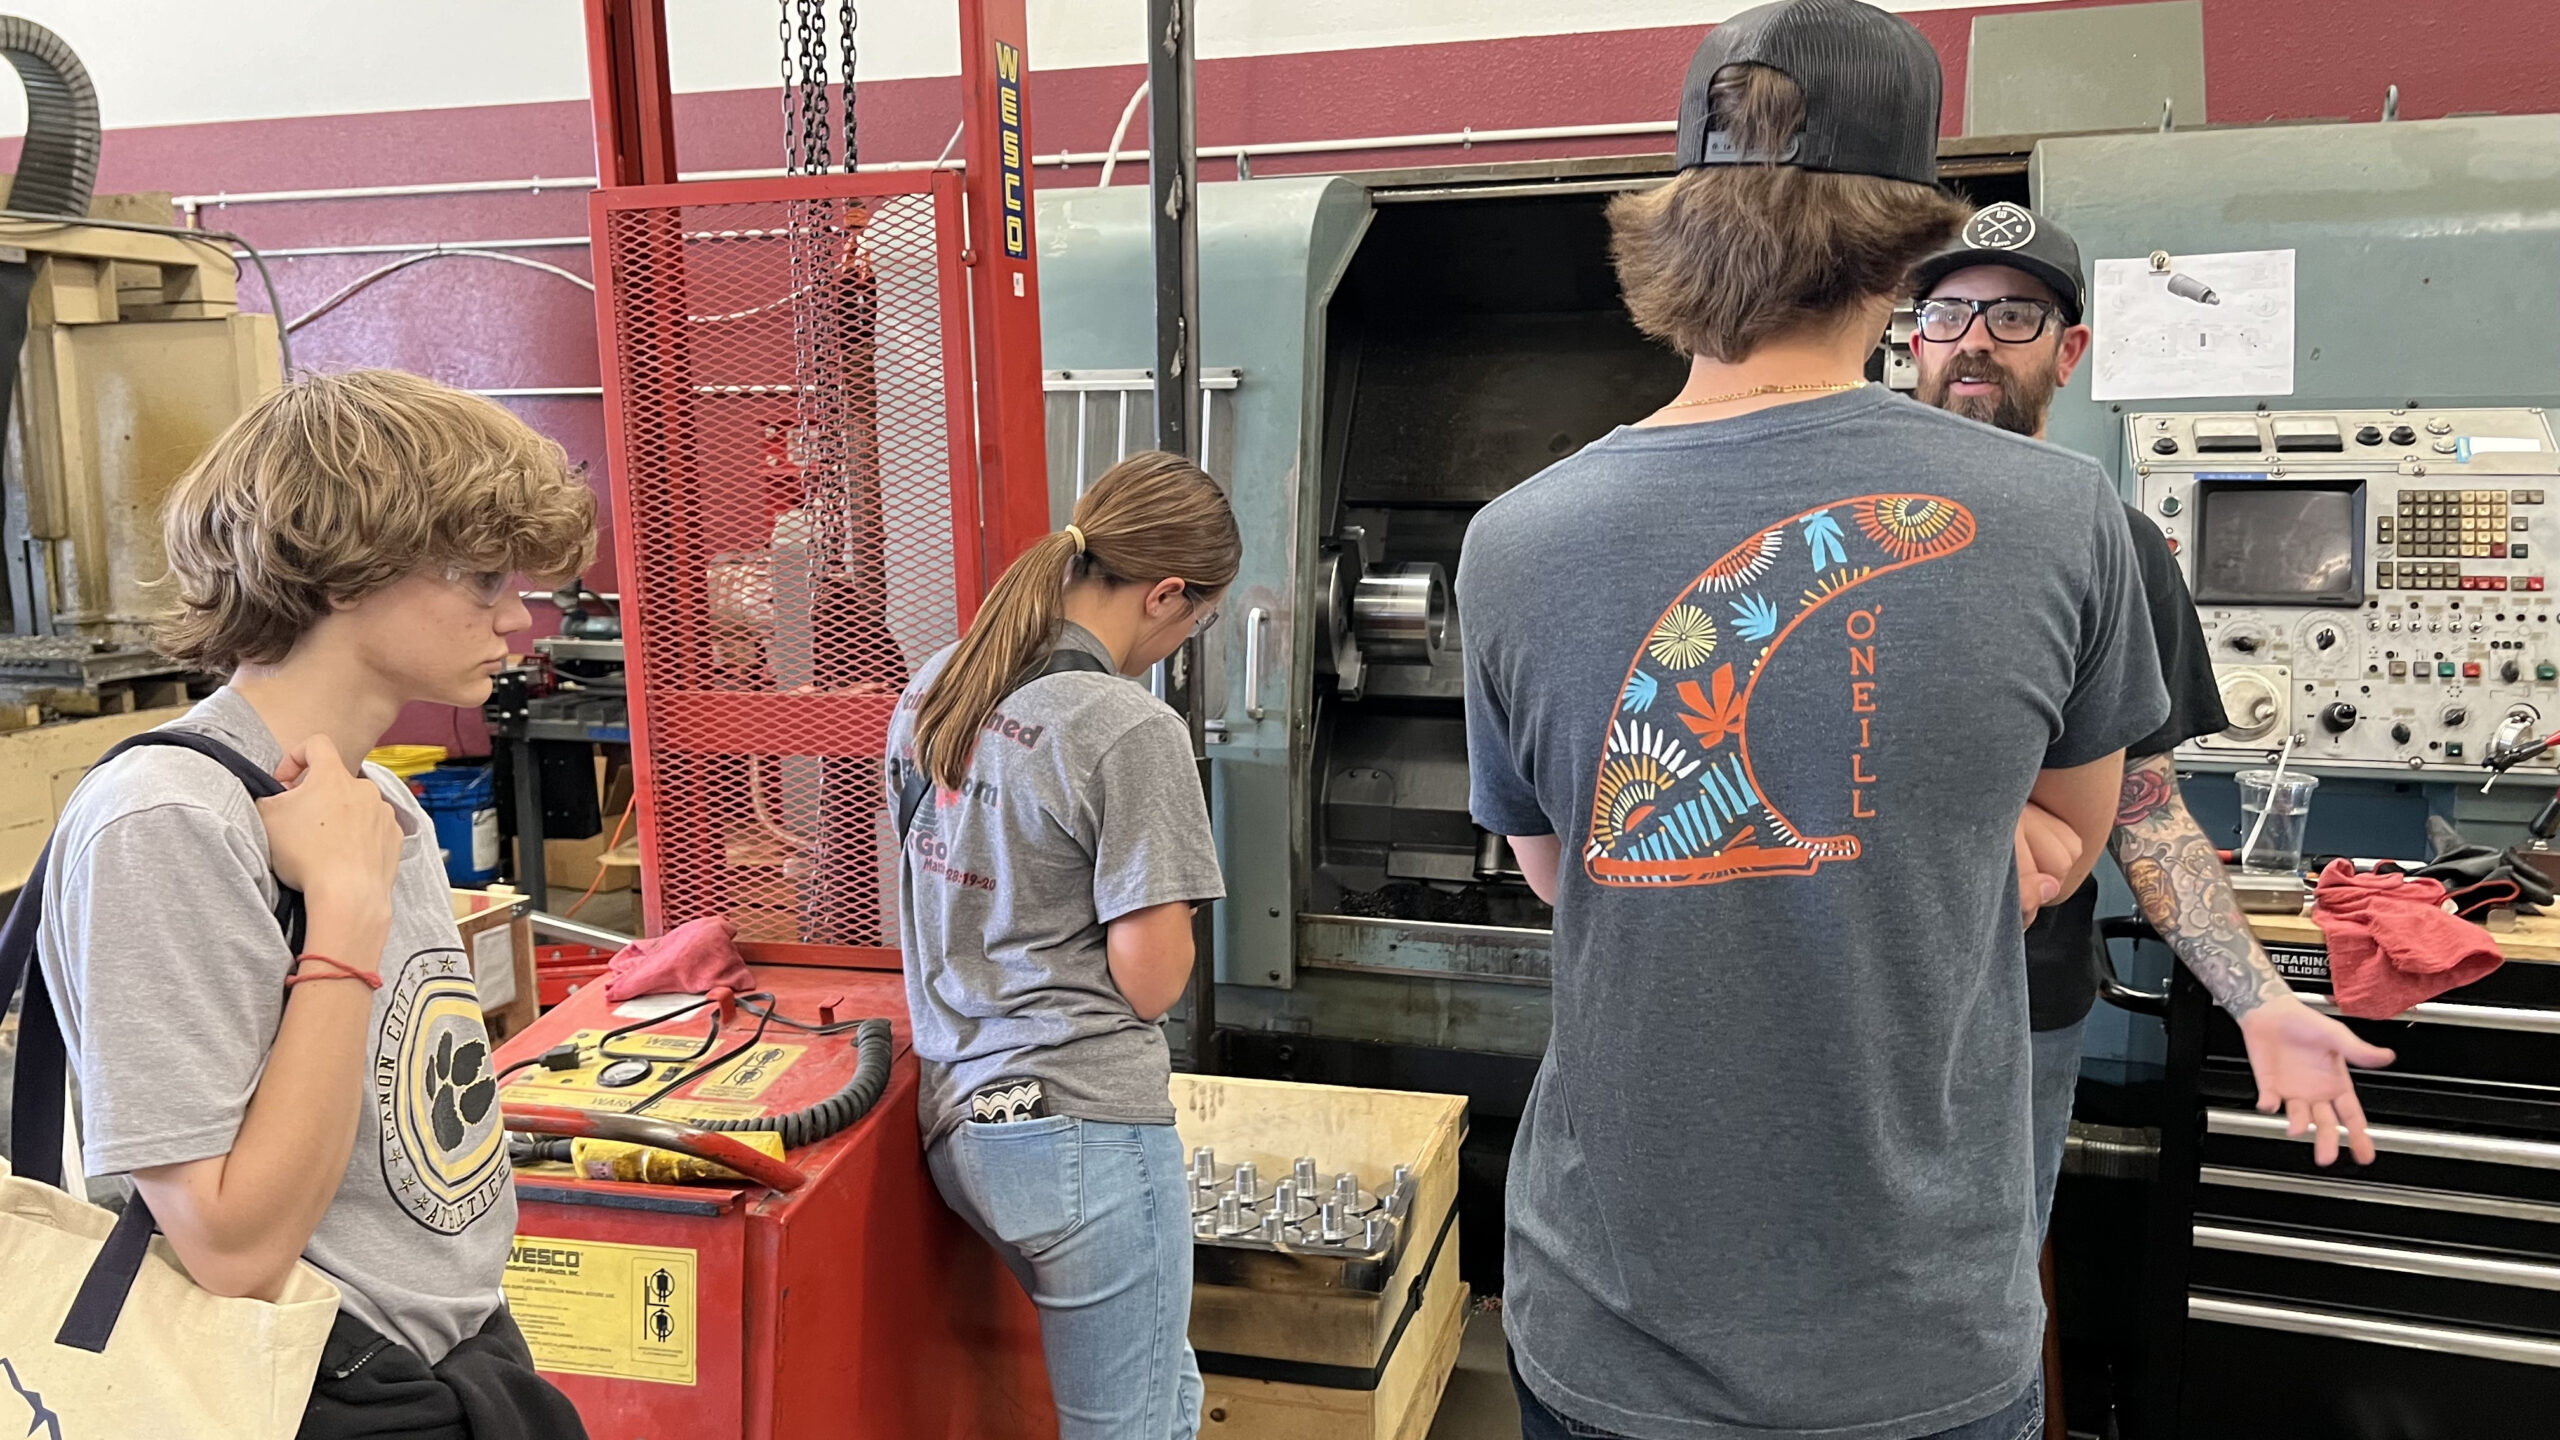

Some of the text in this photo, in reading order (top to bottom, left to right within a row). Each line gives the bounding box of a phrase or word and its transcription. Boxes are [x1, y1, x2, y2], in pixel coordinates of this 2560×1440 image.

[996, 41, 1023, 253] WESCO
[1846, 604, 1882, 818] O'NEILL
[946, 868, 997, 891] 28:19-20
[2287, 965, 2328, 976] SLIDES
[386, 988, 410, 1042] CITY
[592, 1097, 661, 1109] WARNG
